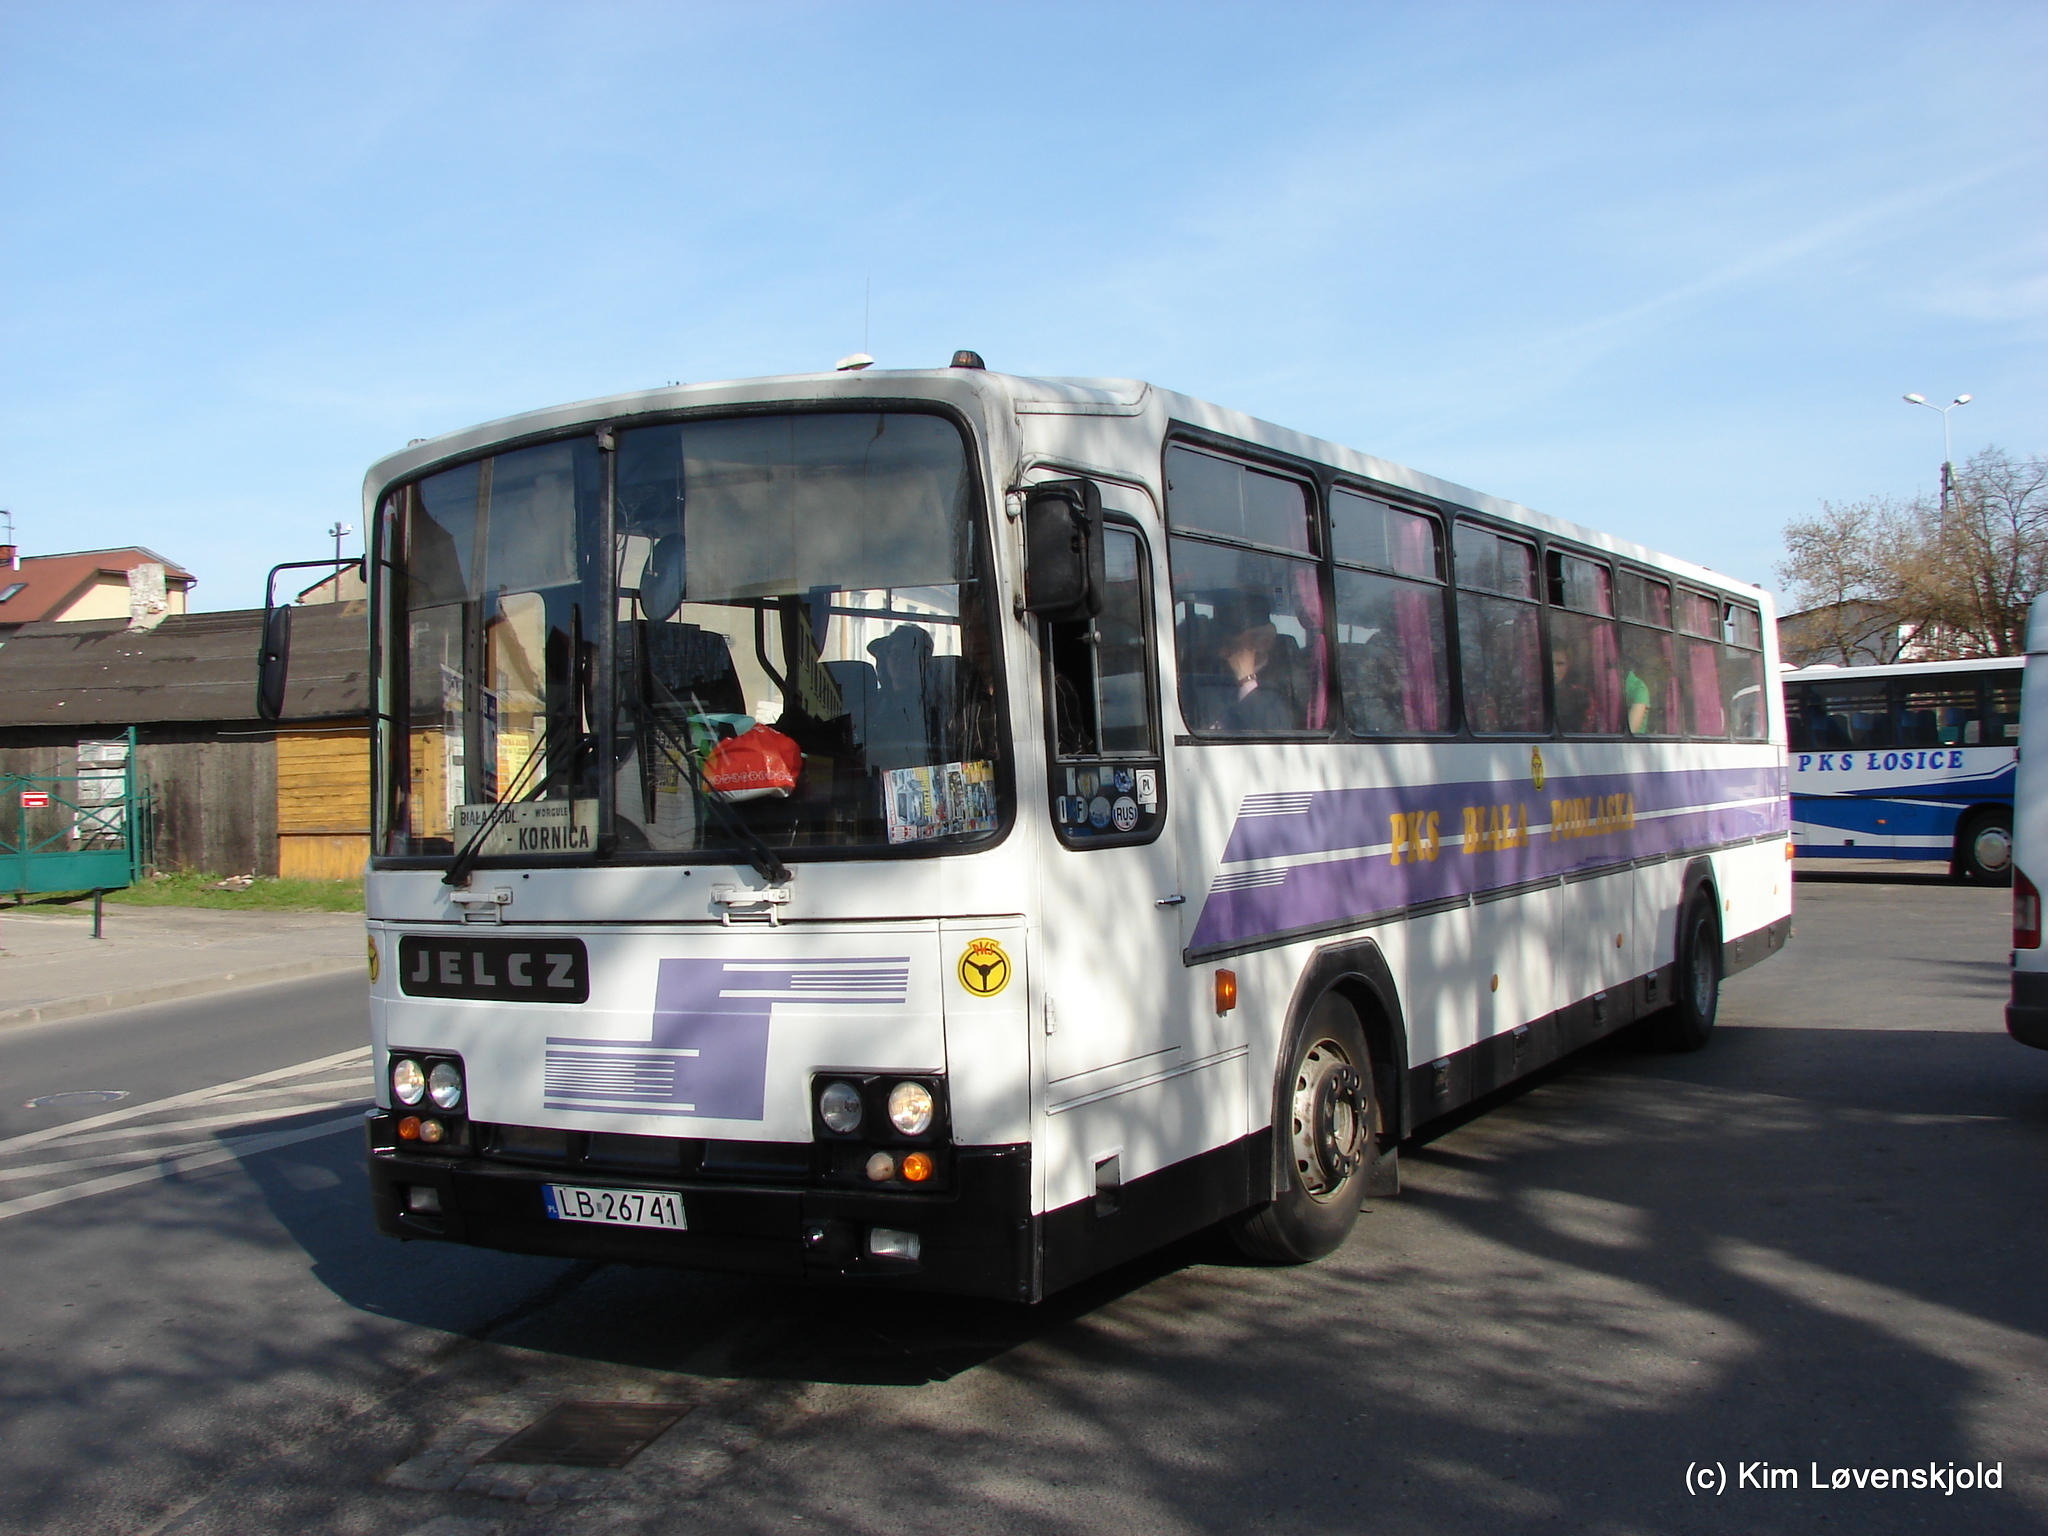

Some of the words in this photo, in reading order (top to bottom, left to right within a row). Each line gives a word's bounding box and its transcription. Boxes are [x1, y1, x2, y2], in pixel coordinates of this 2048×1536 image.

[1797, 753, 1853, 772] PKS
[1866, 750, 1963, 771] ŁOSICE
[460, 810, 488, 826] BIAŁA
[1116, 806, 1135, 821] RUS
[519, 825, 589, 850] KORNICA
[1389, 810, 1440, 866] PKS
[1462, 803, 1528, 855] BIAŁA
[1551, 792, 1635, 842] PODLASKA
[972, 941, 996, 956] PKS
[412, 950, 575, 988] JELCZ
[559, 1189, 595, 1218] LB
[602, 1192, 677, 1225] 26741
